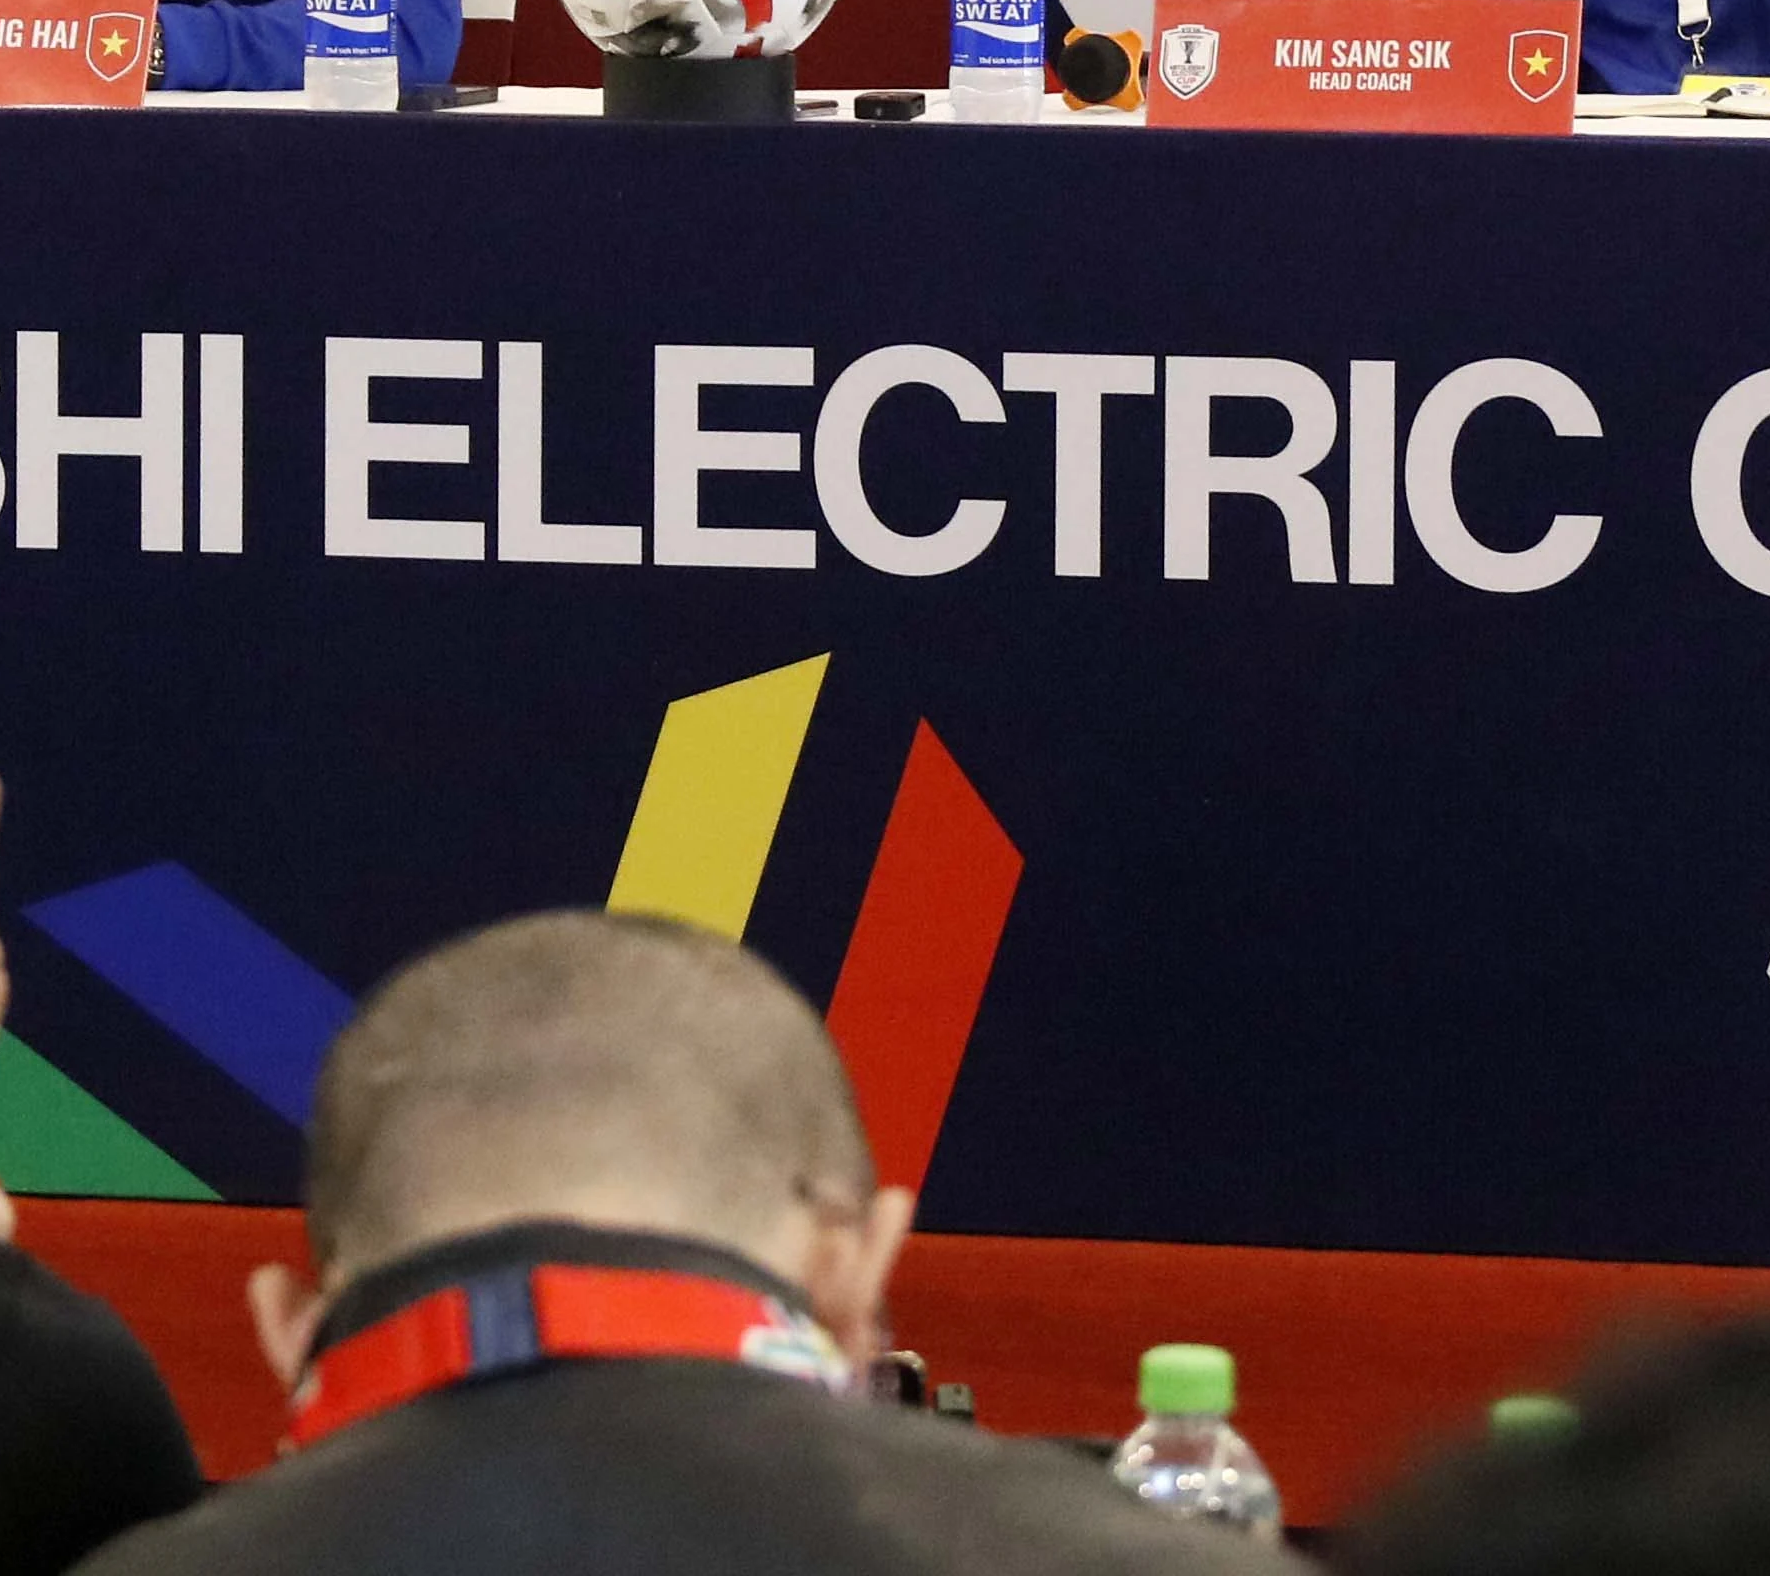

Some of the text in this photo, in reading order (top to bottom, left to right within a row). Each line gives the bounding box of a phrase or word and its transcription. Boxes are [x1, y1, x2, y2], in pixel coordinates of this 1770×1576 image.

[956, 2, 1031, 20] SWEAT
[32, 20, 78, 49] HAI
[1275, 40, 1451, 68] KIM SANG SIK
[1310, 72, 1411, 90] HEAD COACH
[325, 337, 1603, 592] ELECTRIC
